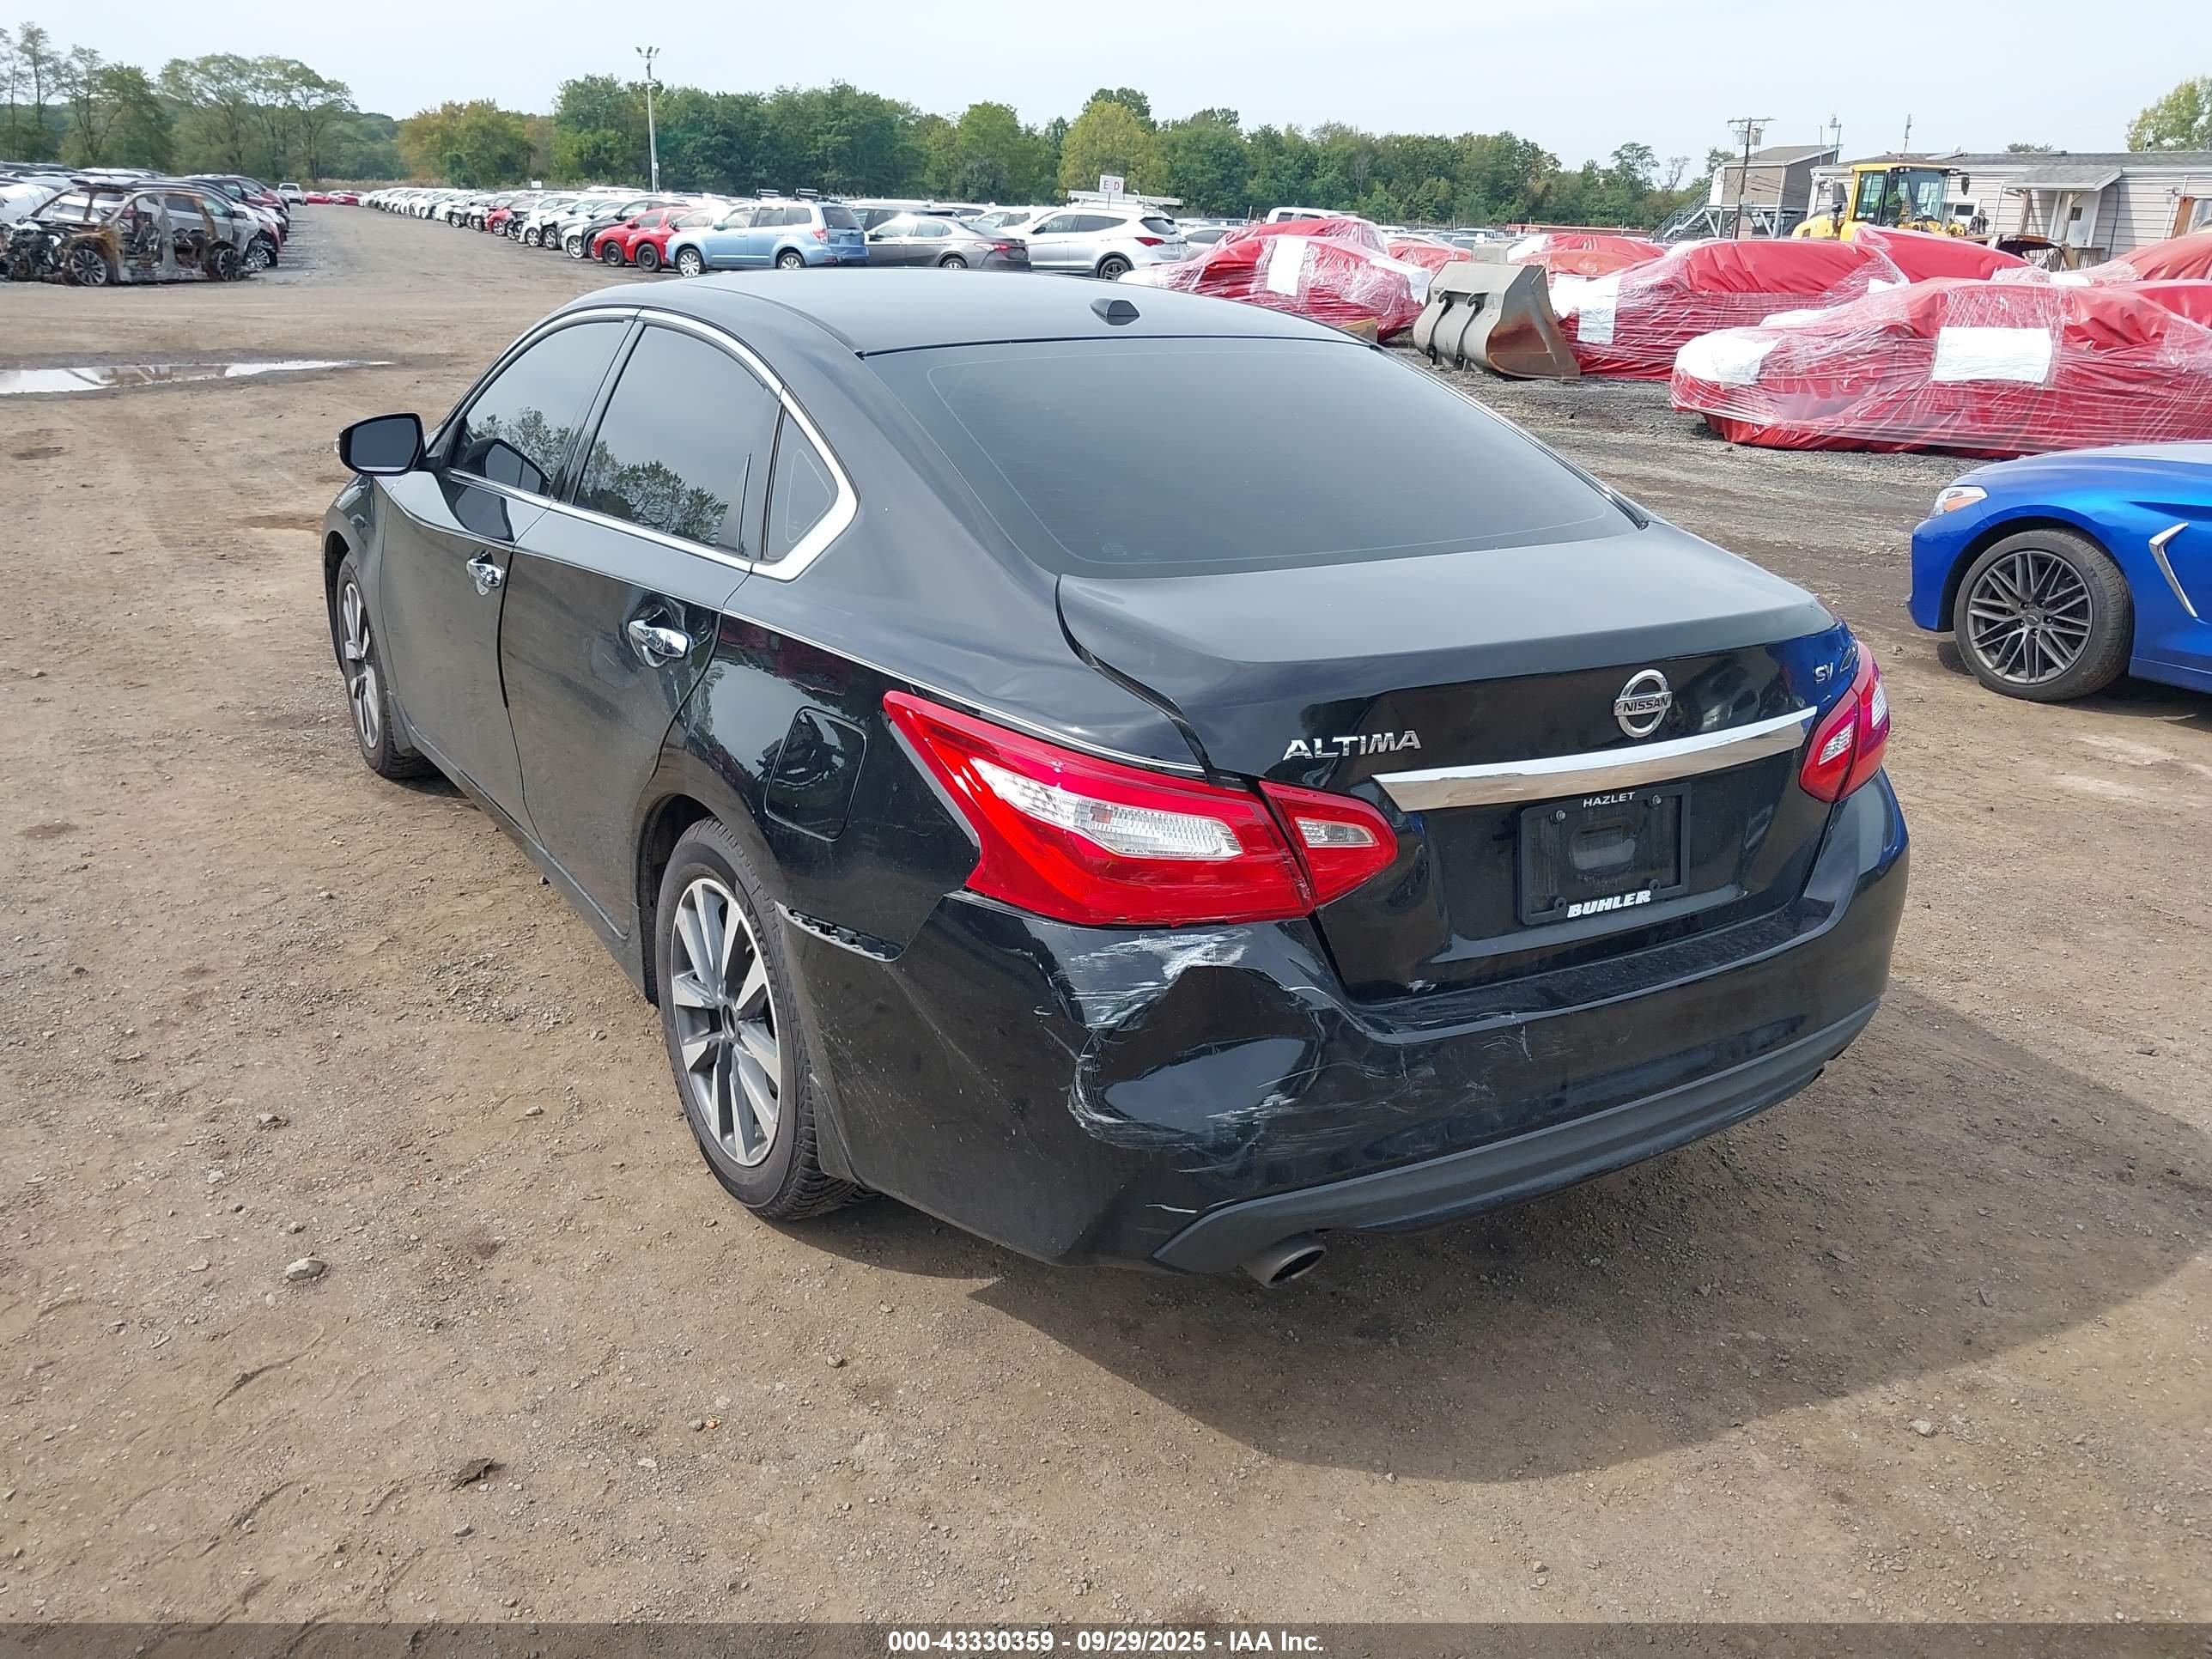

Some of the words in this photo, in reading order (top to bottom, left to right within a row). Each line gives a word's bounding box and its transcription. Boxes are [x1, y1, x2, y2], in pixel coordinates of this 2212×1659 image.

[1814, 662, 1833, 683] SV
[1623, 696, 1668, 713] NISSAN
[1283, 730, 1422, 761] ALTIMA
[1583, 791, 1636, 808] HAZLET
[1567, 890, 1651, 919] BUHLER
